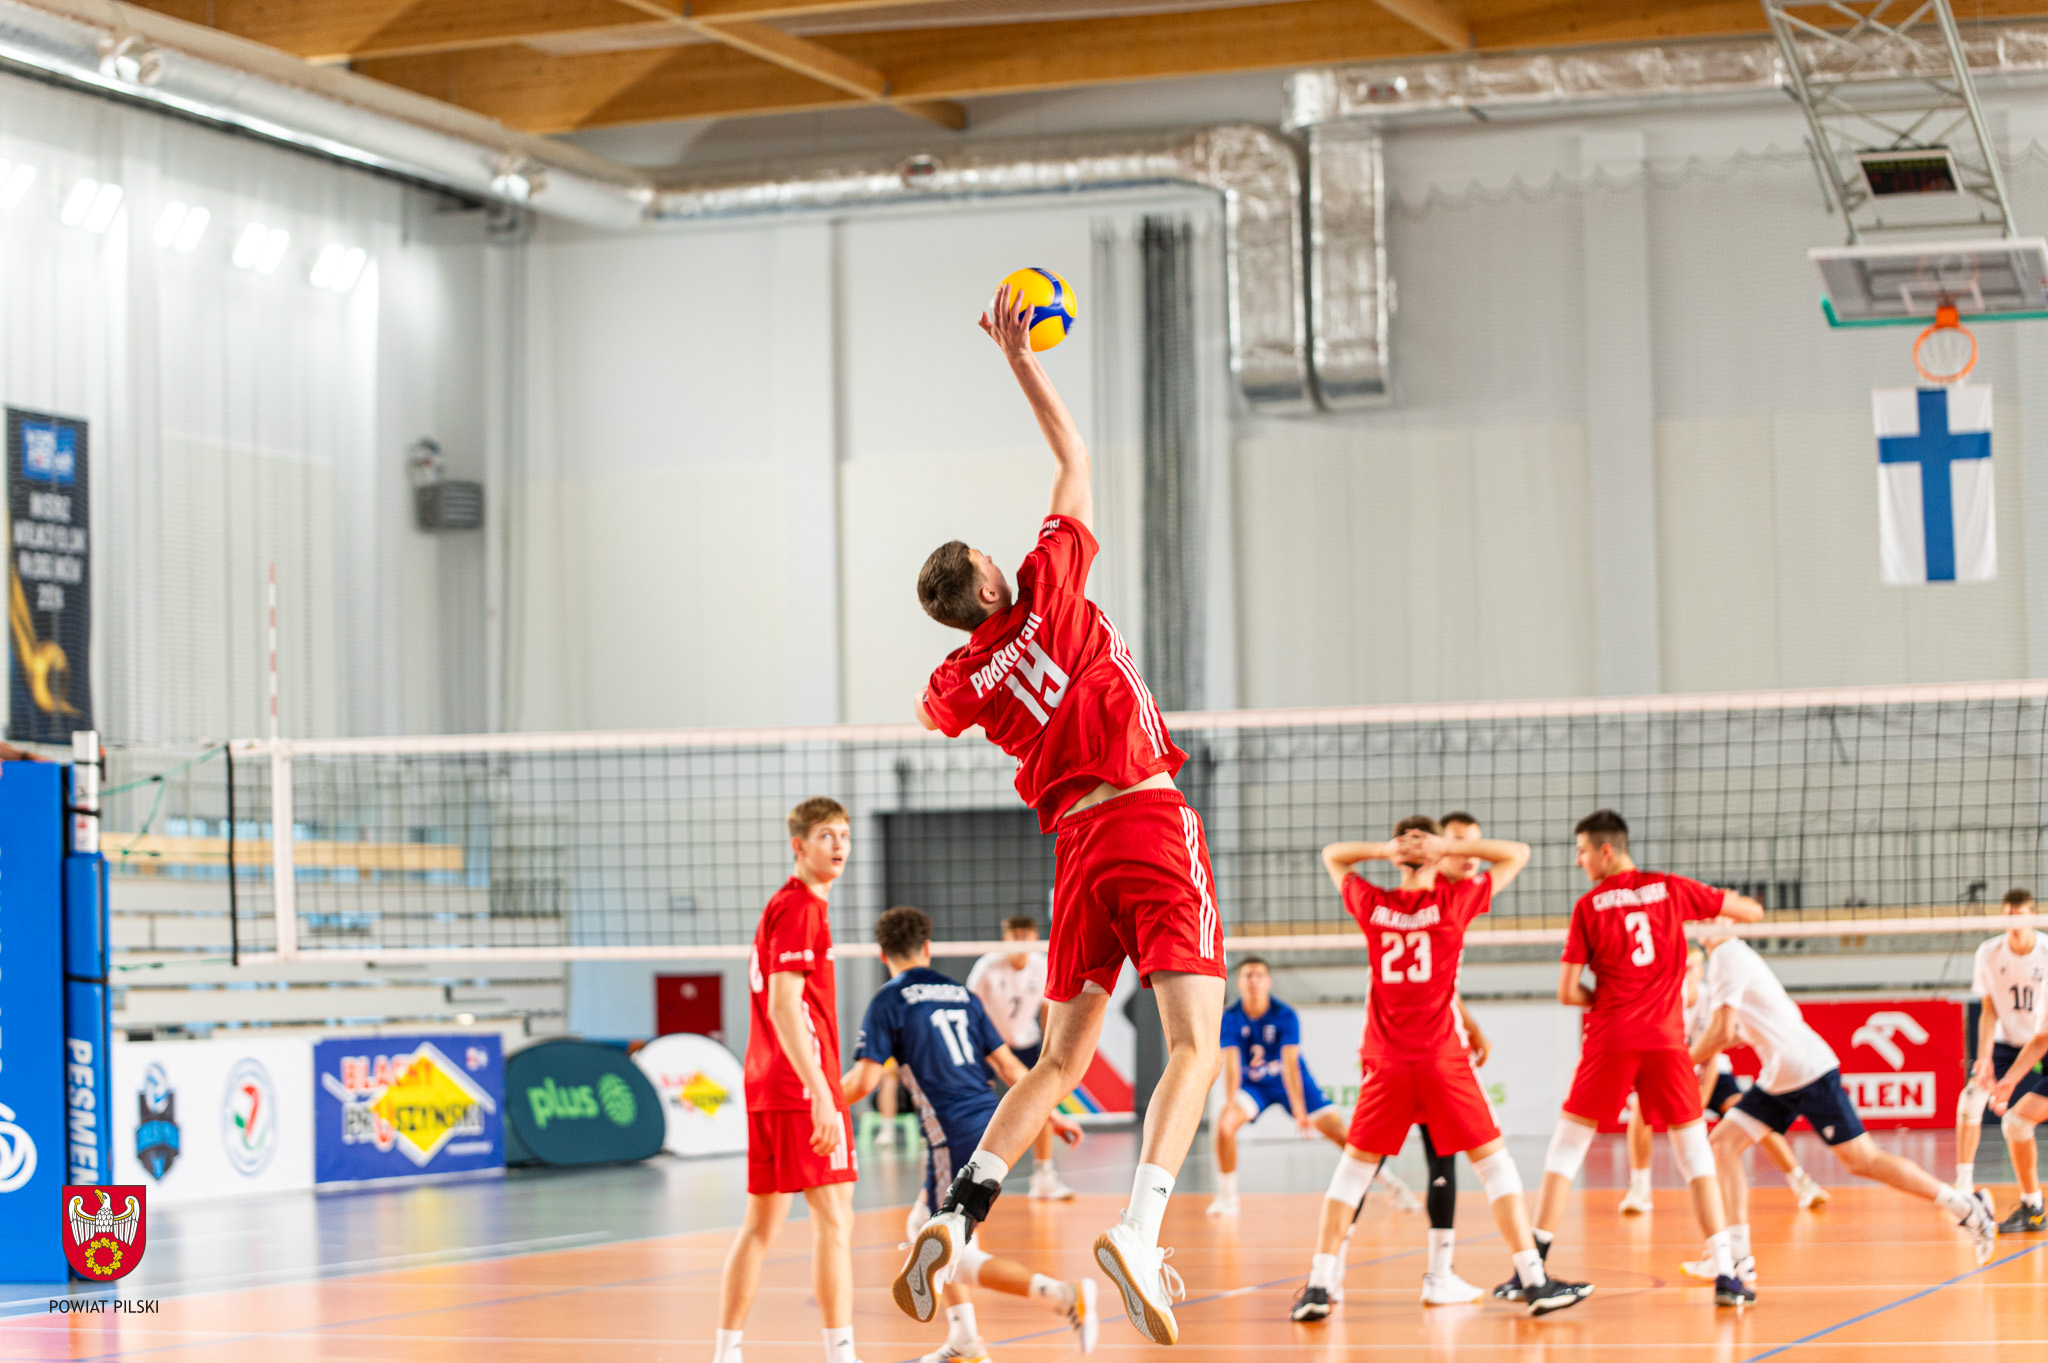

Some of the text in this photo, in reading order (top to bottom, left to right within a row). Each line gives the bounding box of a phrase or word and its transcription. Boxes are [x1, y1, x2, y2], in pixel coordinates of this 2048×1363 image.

[1381, 930, 1432, 984] 23
[1625, 911, 1655, 967] 3
[2009, 984, 2034, 1012] 10
[930, 1008, 976, 1067] 17
[527, 1076, 599, 1129] plus
